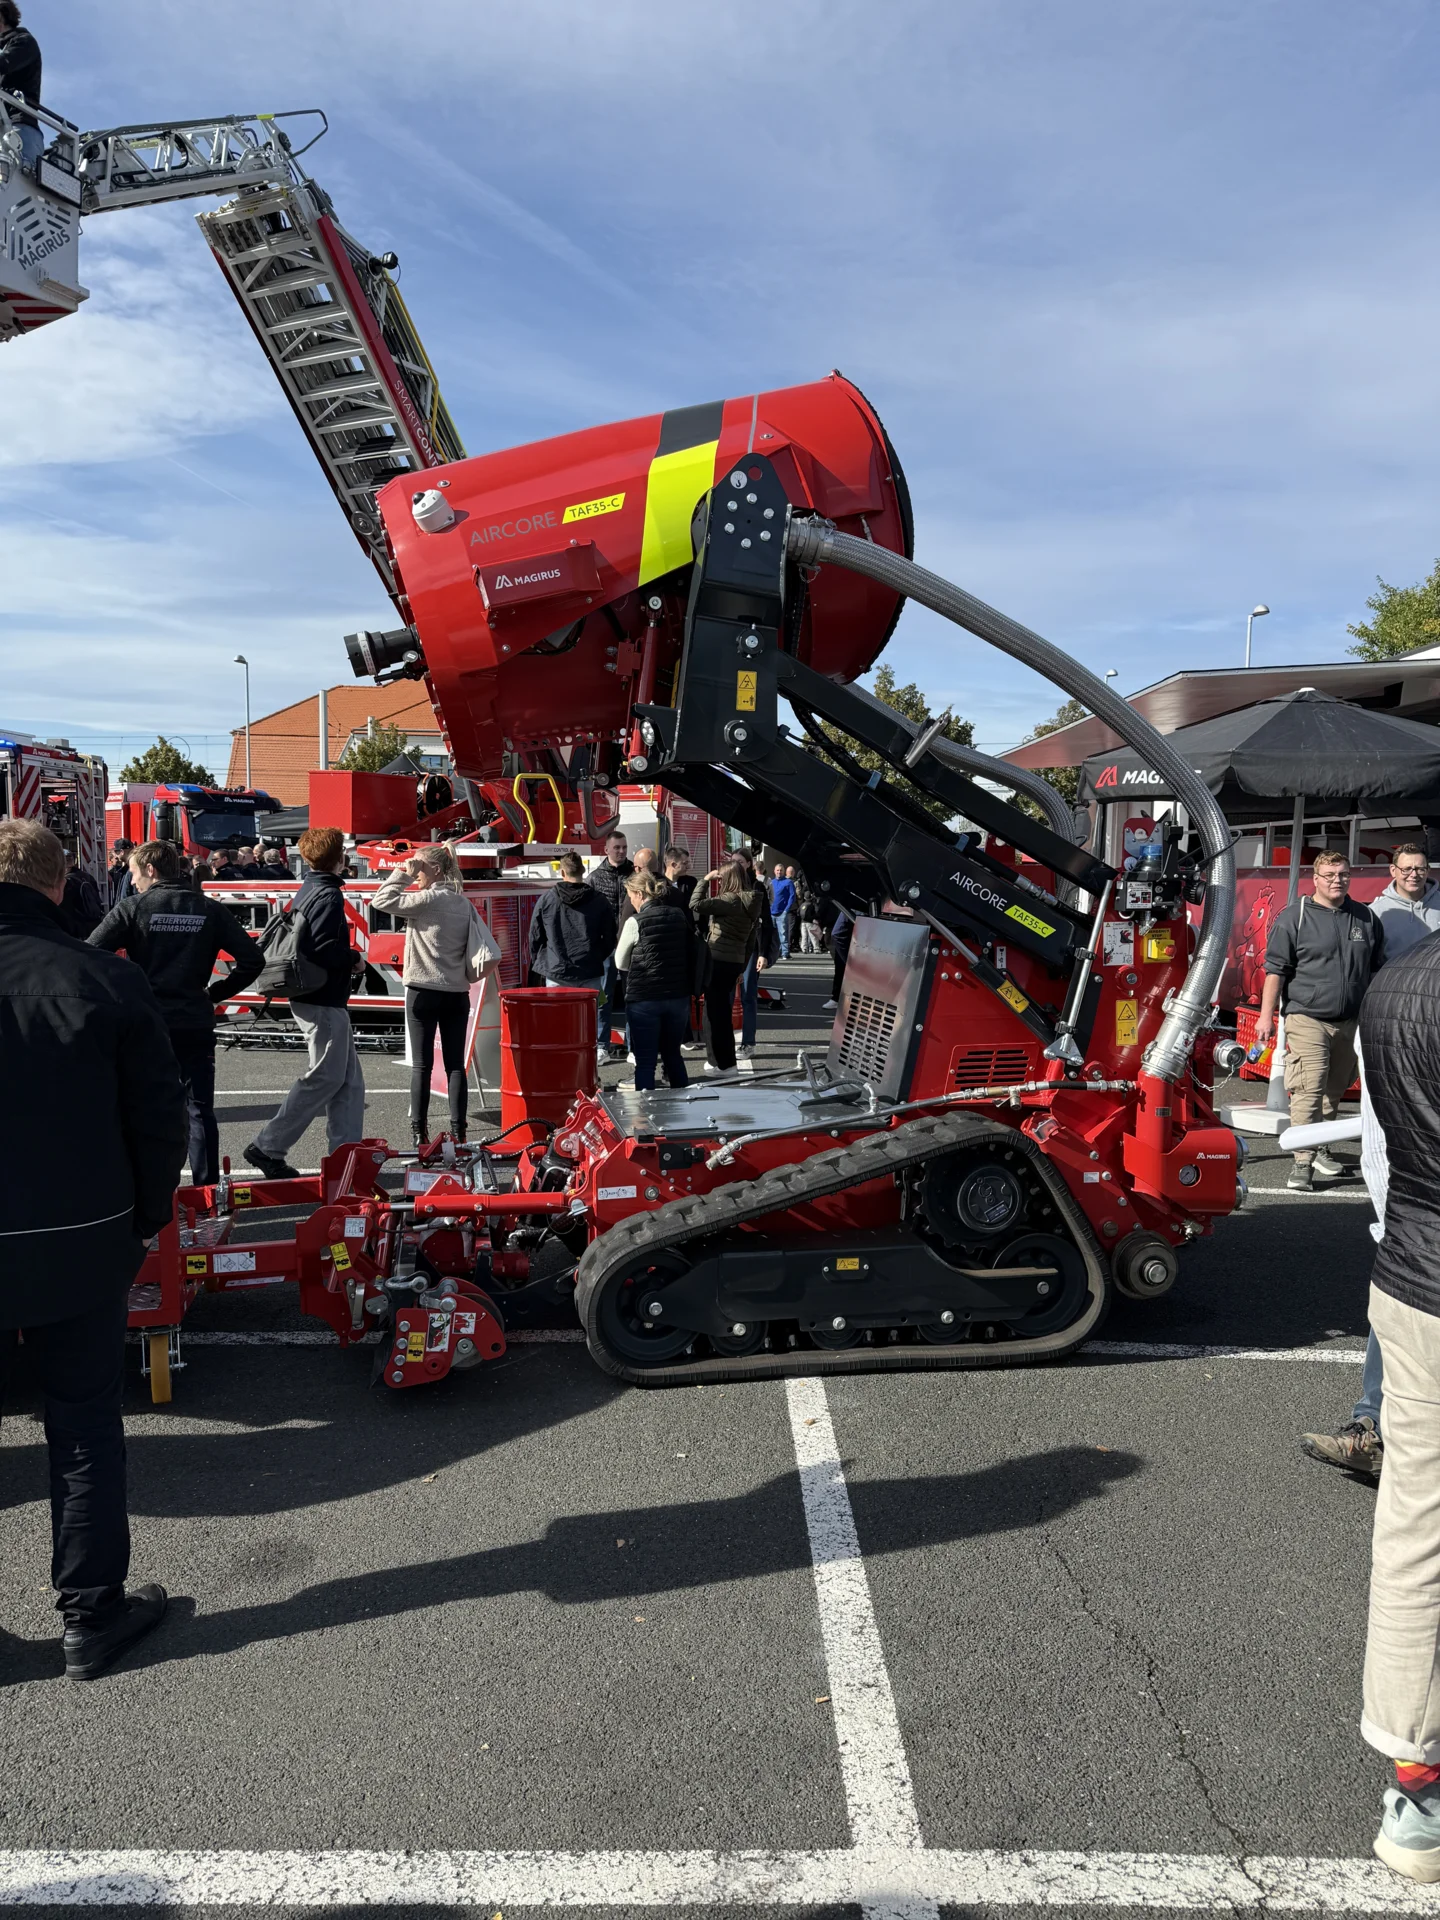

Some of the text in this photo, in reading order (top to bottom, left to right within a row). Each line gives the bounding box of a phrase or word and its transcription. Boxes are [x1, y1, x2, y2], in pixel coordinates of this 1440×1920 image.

[18, 229, 71, 271] MAGIRUS
[470, 498, 620, 546] AIRCORE TAF35-C
[514, 568, 561, 585] MAGIRUS
[149, 914, 206, 925] FEUERWEHR
[949, 871, 1049, 935] AIRCORE TAF35-C
